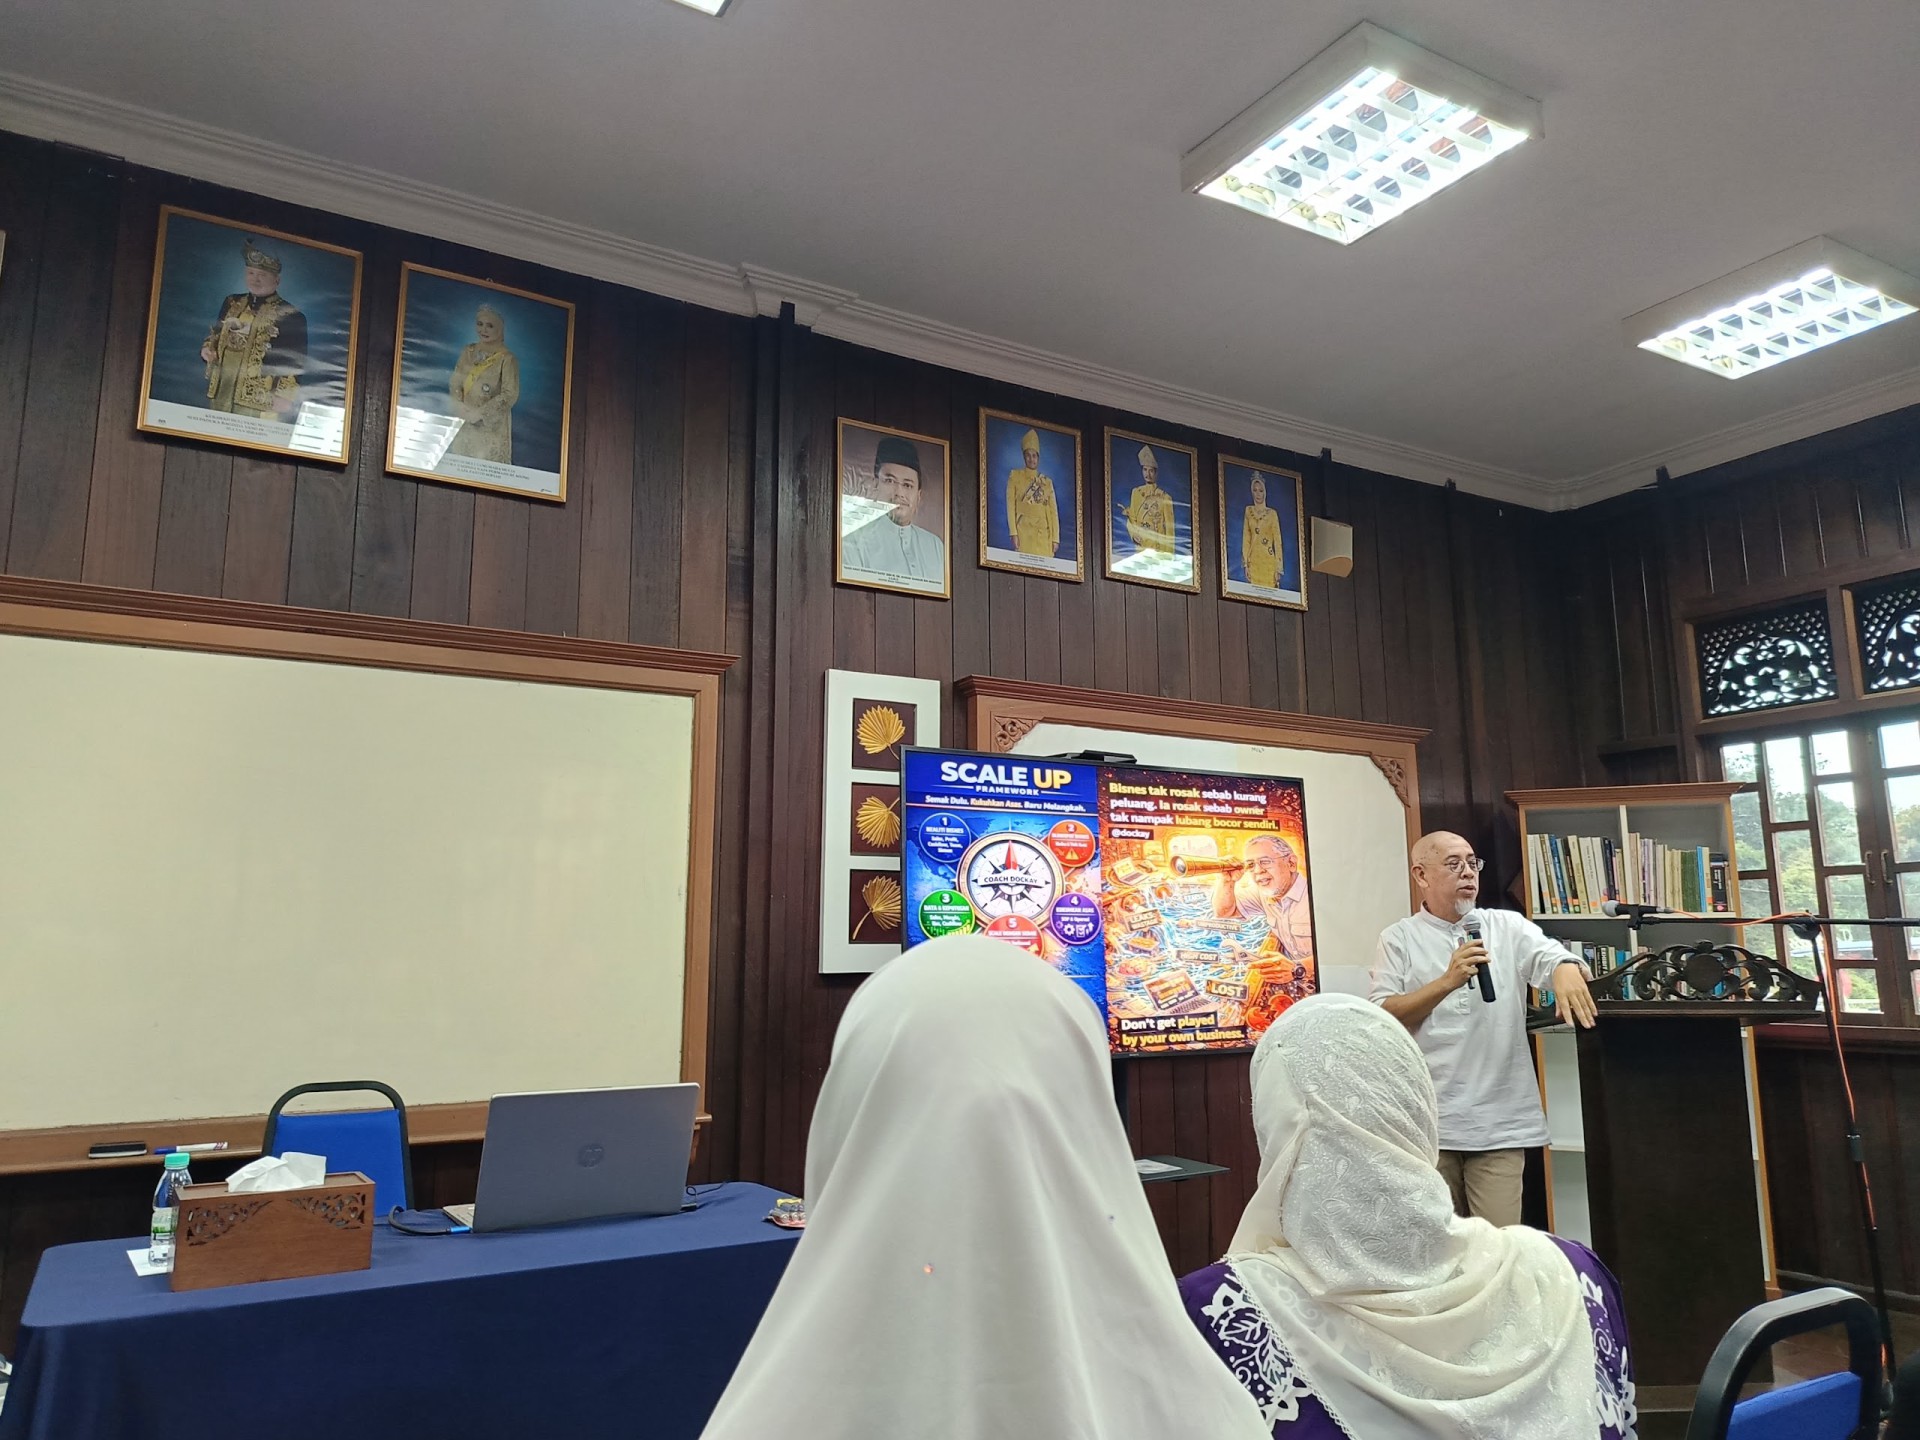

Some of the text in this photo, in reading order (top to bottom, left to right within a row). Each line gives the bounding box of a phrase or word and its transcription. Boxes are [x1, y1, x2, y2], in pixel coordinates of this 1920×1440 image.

[941, 761, 1072, 790] SCALE UP
[976, 785, 1040, 796] FRAMEWORK
[1109, 782, 1266, 805] Bisnes tak rosak sebab kurang
[925, 795, 1086, 813] Semak Dulu. Kukuhkan Asas. Baru Melangkah.
[1110, 798, 1157, 812] peluang.
[1172, 801, 1201, 812] rosak
[1202, 802, 1233, 814] sebab
[1234, 806, 1265, 816] owner
[942, 816, 948, 826] 1
[1110, 812, 1278, 830] tak nampak lubang bocor sendiri.
[1067, 824, 1075, 832] 2
[1111, 828, 1150, 840] @dockay
[1010, 876, 1038, 884] DOCKAY
[942, 893, 950, 903] 3
[1070, 896, 1079, 906] 4
[1008, 917, 1018, 928] 5
[1199, 952, 1218, 961] COST
[1211, 984, 1244, 998] LOST
[1121, 1014, 1215, 1031] Don't get played
[1122, 1029, 1245, 1048] by your own business.
